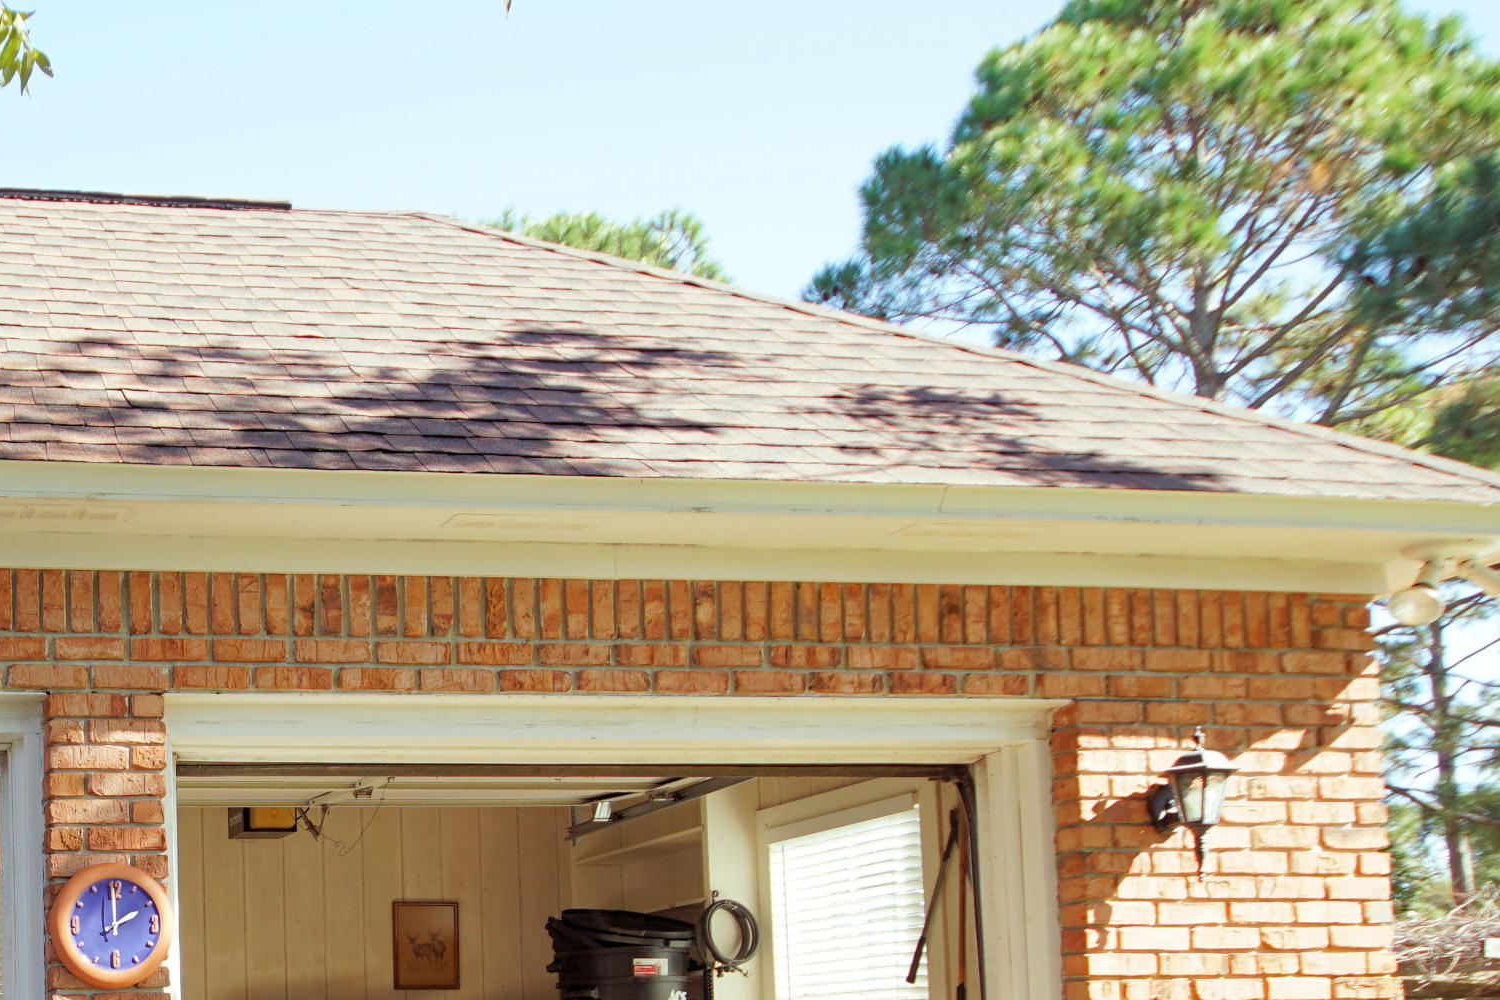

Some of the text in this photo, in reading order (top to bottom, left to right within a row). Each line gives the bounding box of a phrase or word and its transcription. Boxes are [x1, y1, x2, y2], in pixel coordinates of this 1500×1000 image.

[108, 880, 122, 900] 12
[70, 915, 79, 935] 9
[149, 914, 159, 934] 3
[110, 950, 120, 969] 6
